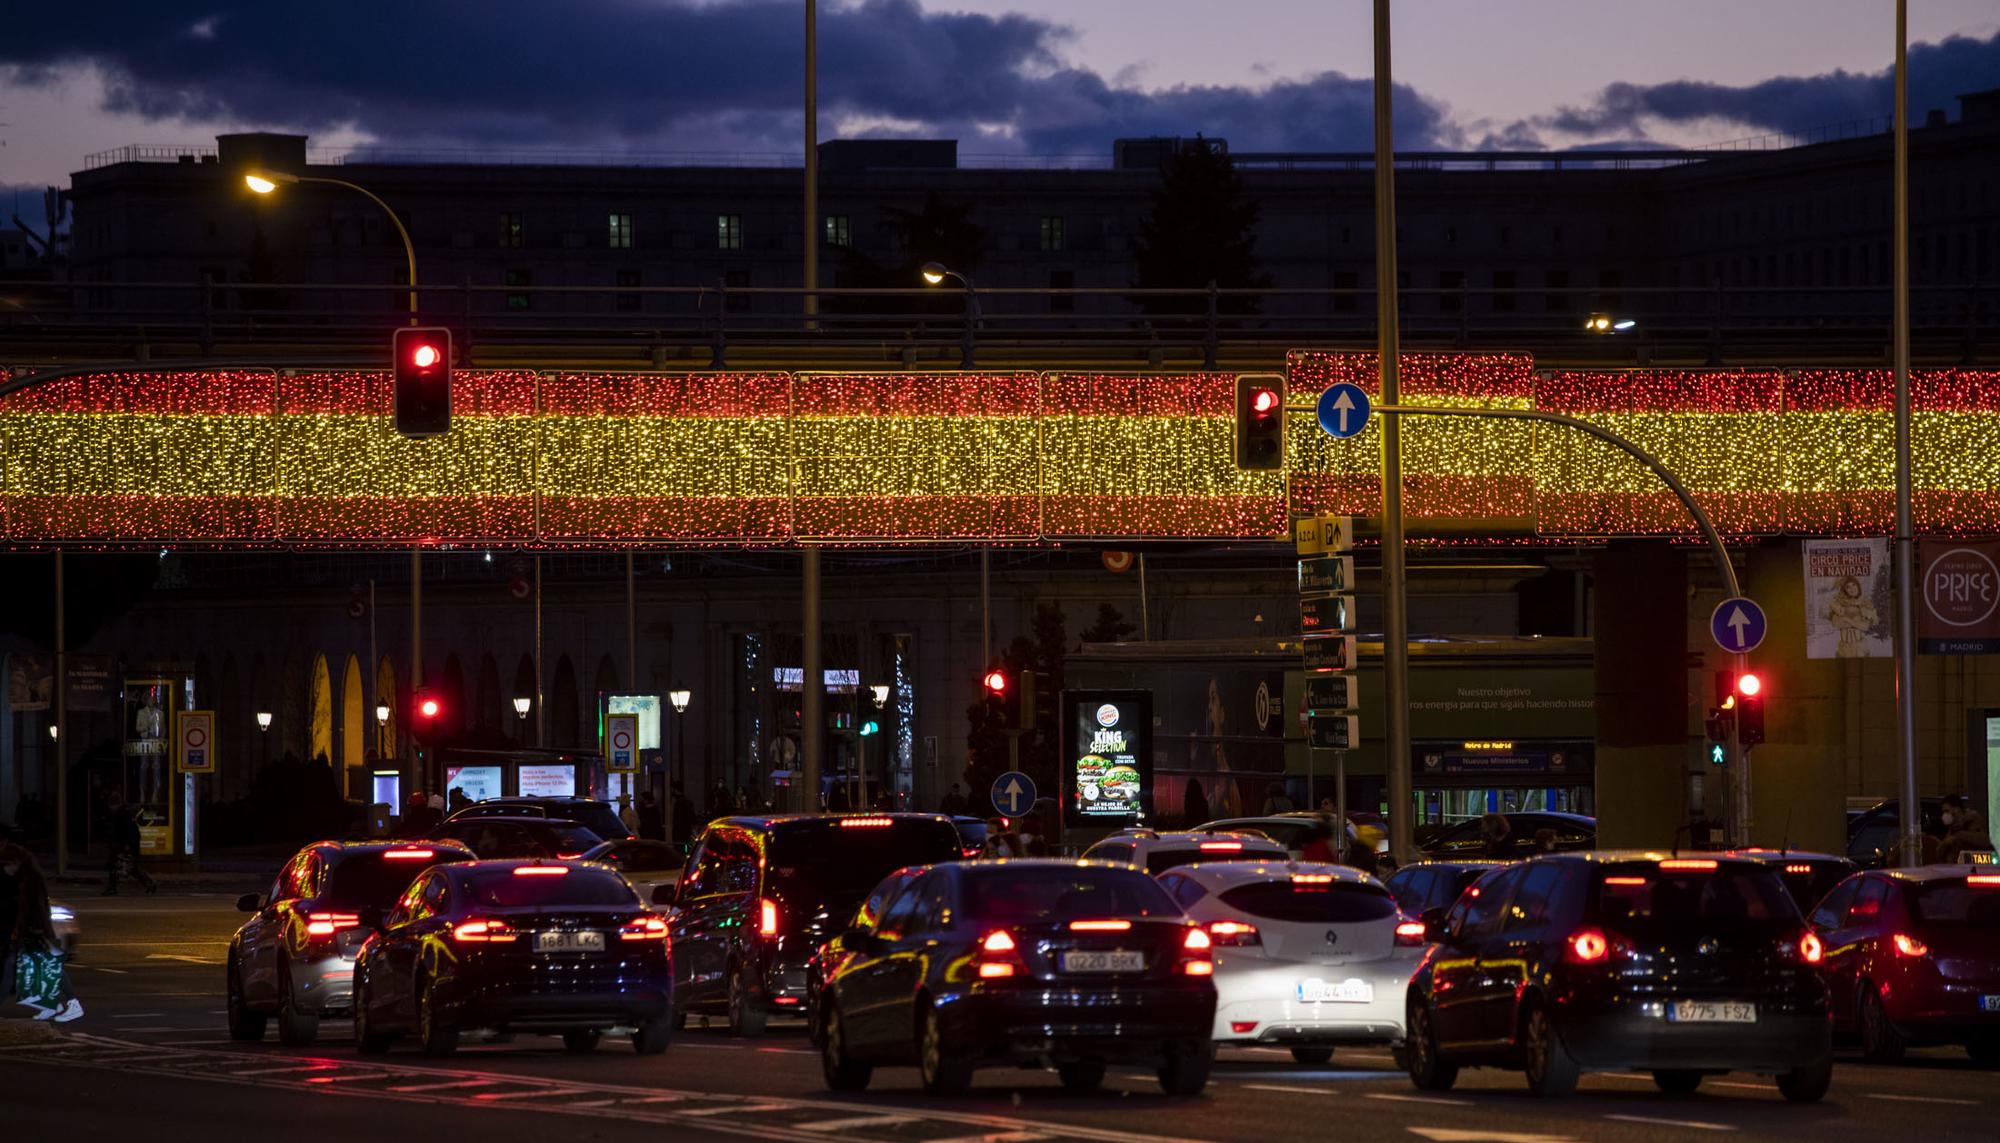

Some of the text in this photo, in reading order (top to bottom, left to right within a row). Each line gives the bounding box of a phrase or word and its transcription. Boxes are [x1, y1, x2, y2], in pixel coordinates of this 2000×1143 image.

[1811, 554, 1870, 566] CIRCO PRICE
[1811, 566, 1870, 577] EN NAVIDAD
[1934, 573, 1991, 602] PRICE
[1950, 643, 1984, 651] MADRID
[1457, 687, 1532, 699] Nuestro objetivo
[1460, 702, 1480, 711] para
[1481, 702, 1499, 711] que
[1526, 699, 1567, 709] haciendo
[1568, 698, 1595, 708] histor
[1094, 731, 1122, 743] KING
[128, 741, 168, 754] WHITNEY
[1089, 740, 1127, 753] SELECTION
[1973, 854, 1991, 864] TAXI
[576, 935, 600, 947] LKC
[1069, 955, 1106, 969] 0220
[1680, 1004, 1751, 1019] 6775 FSZ
